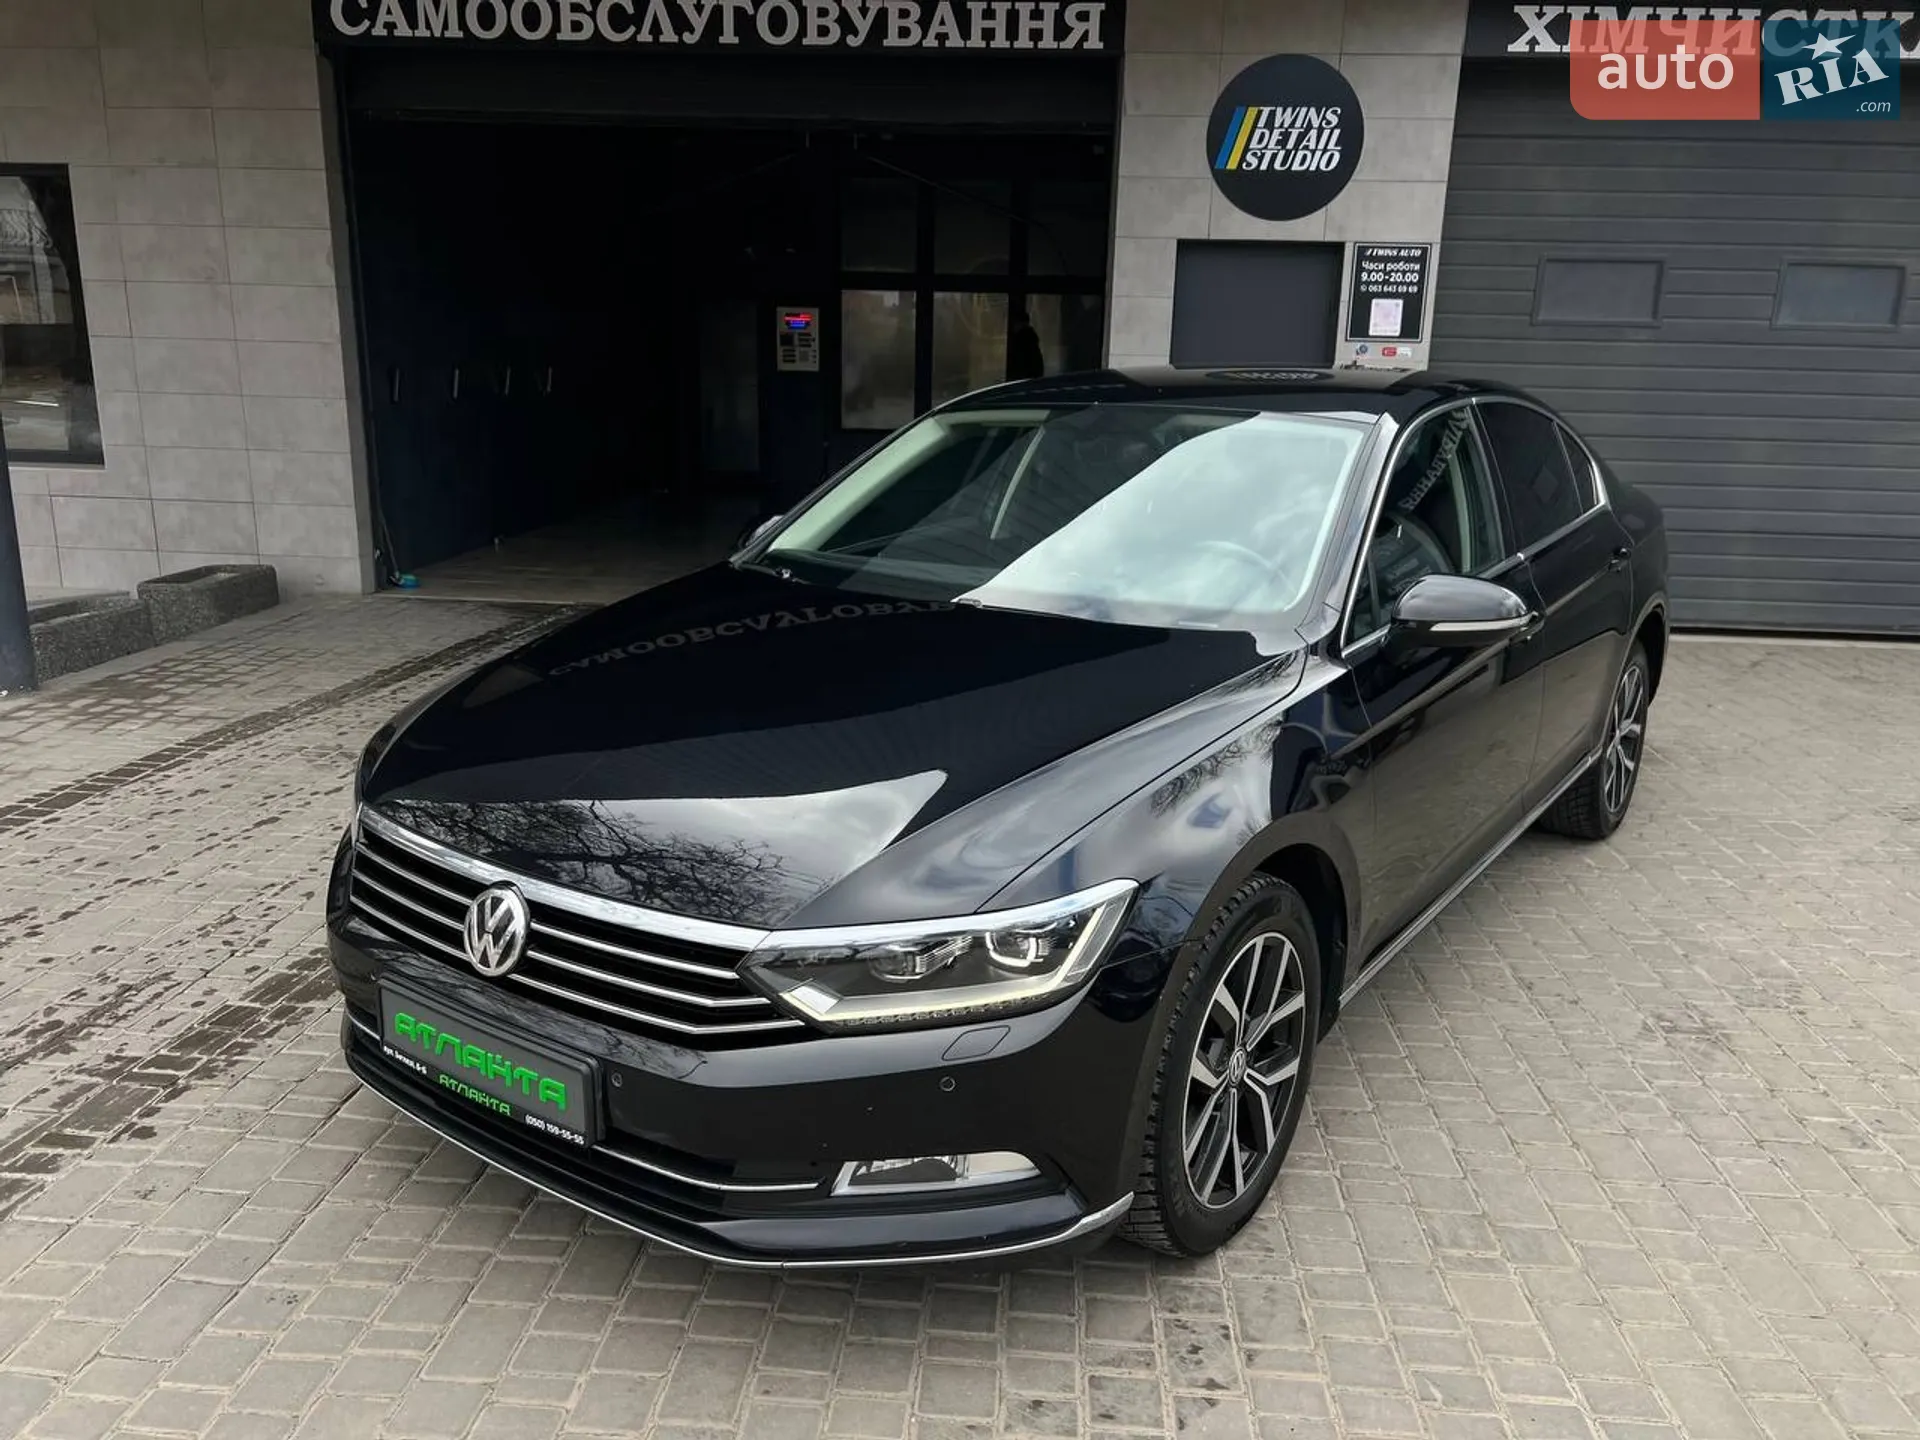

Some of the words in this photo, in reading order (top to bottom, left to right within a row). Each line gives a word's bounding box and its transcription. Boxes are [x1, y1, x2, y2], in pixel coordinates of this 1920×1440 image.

[330, 0, 1106, 50] САМООБСЛУГОВУВАННЯ
[1256, 106, 1341, 128] TWINS
[1249, 128, 1342, 149] DETAIL
[1242, 150, 1341, 171] STUDIO
[1361, 261, 1385, 270] Часи
[1386, 261, 1420, 271] роботи
